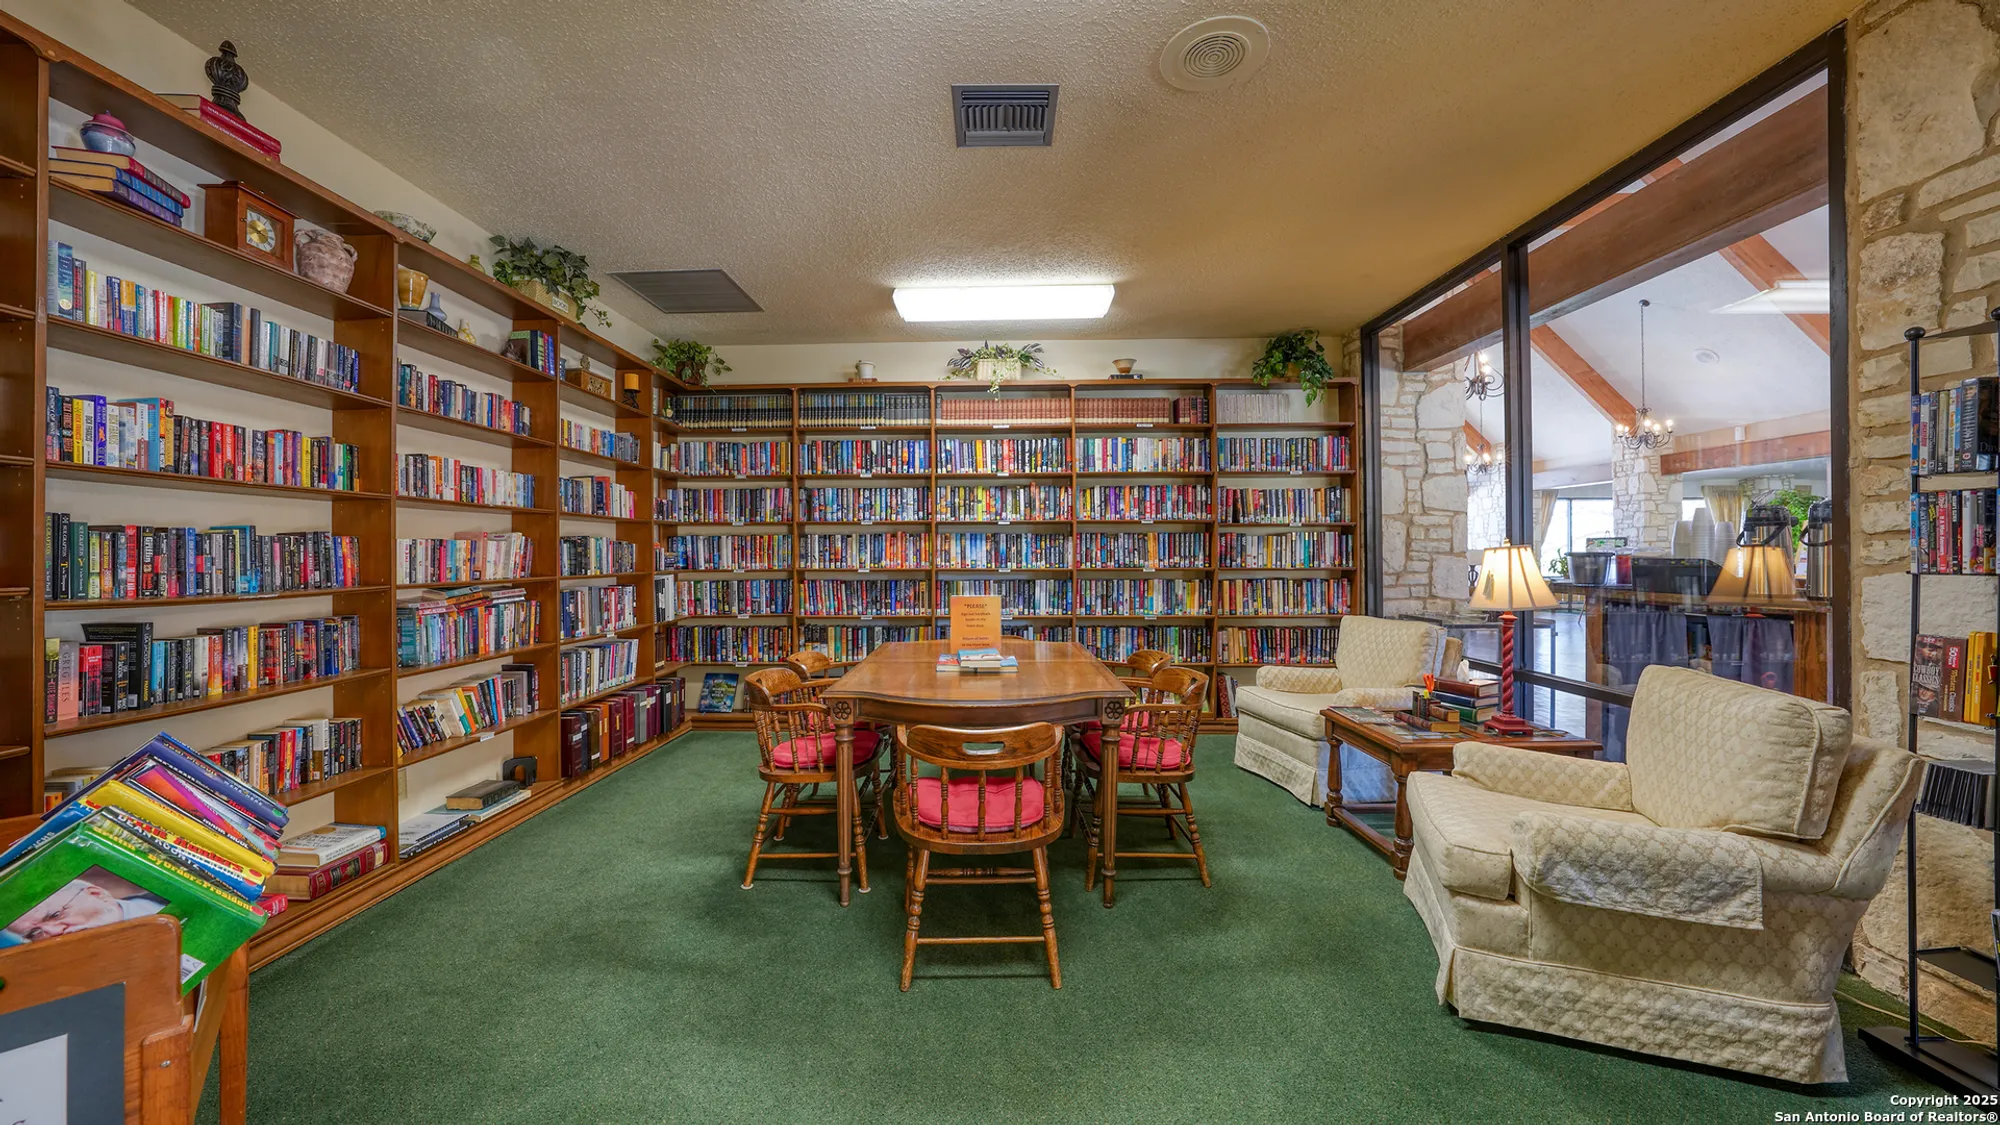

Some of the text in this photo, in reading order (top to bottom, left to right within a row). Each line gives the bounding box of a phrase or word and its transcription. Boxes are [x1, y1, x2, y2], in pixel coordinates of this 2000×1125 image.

[85, 415, 93, 424] DICK
[85, 425, 93, 442] FRANCIS
[144, 537, 153, 563] Griffin
[1949, 647, 1958, 656] 50
[1913, 663, 1939, 674] COWBOY
[62, 652, 70, 703] GREG ILES
[1912, 673, 1939, 686] CLASSICS
[1948, 692, 1957, 713] Classics
[117, 812, 152, 840] DEAN
[154, 836, 201, 871] KOONTZ
